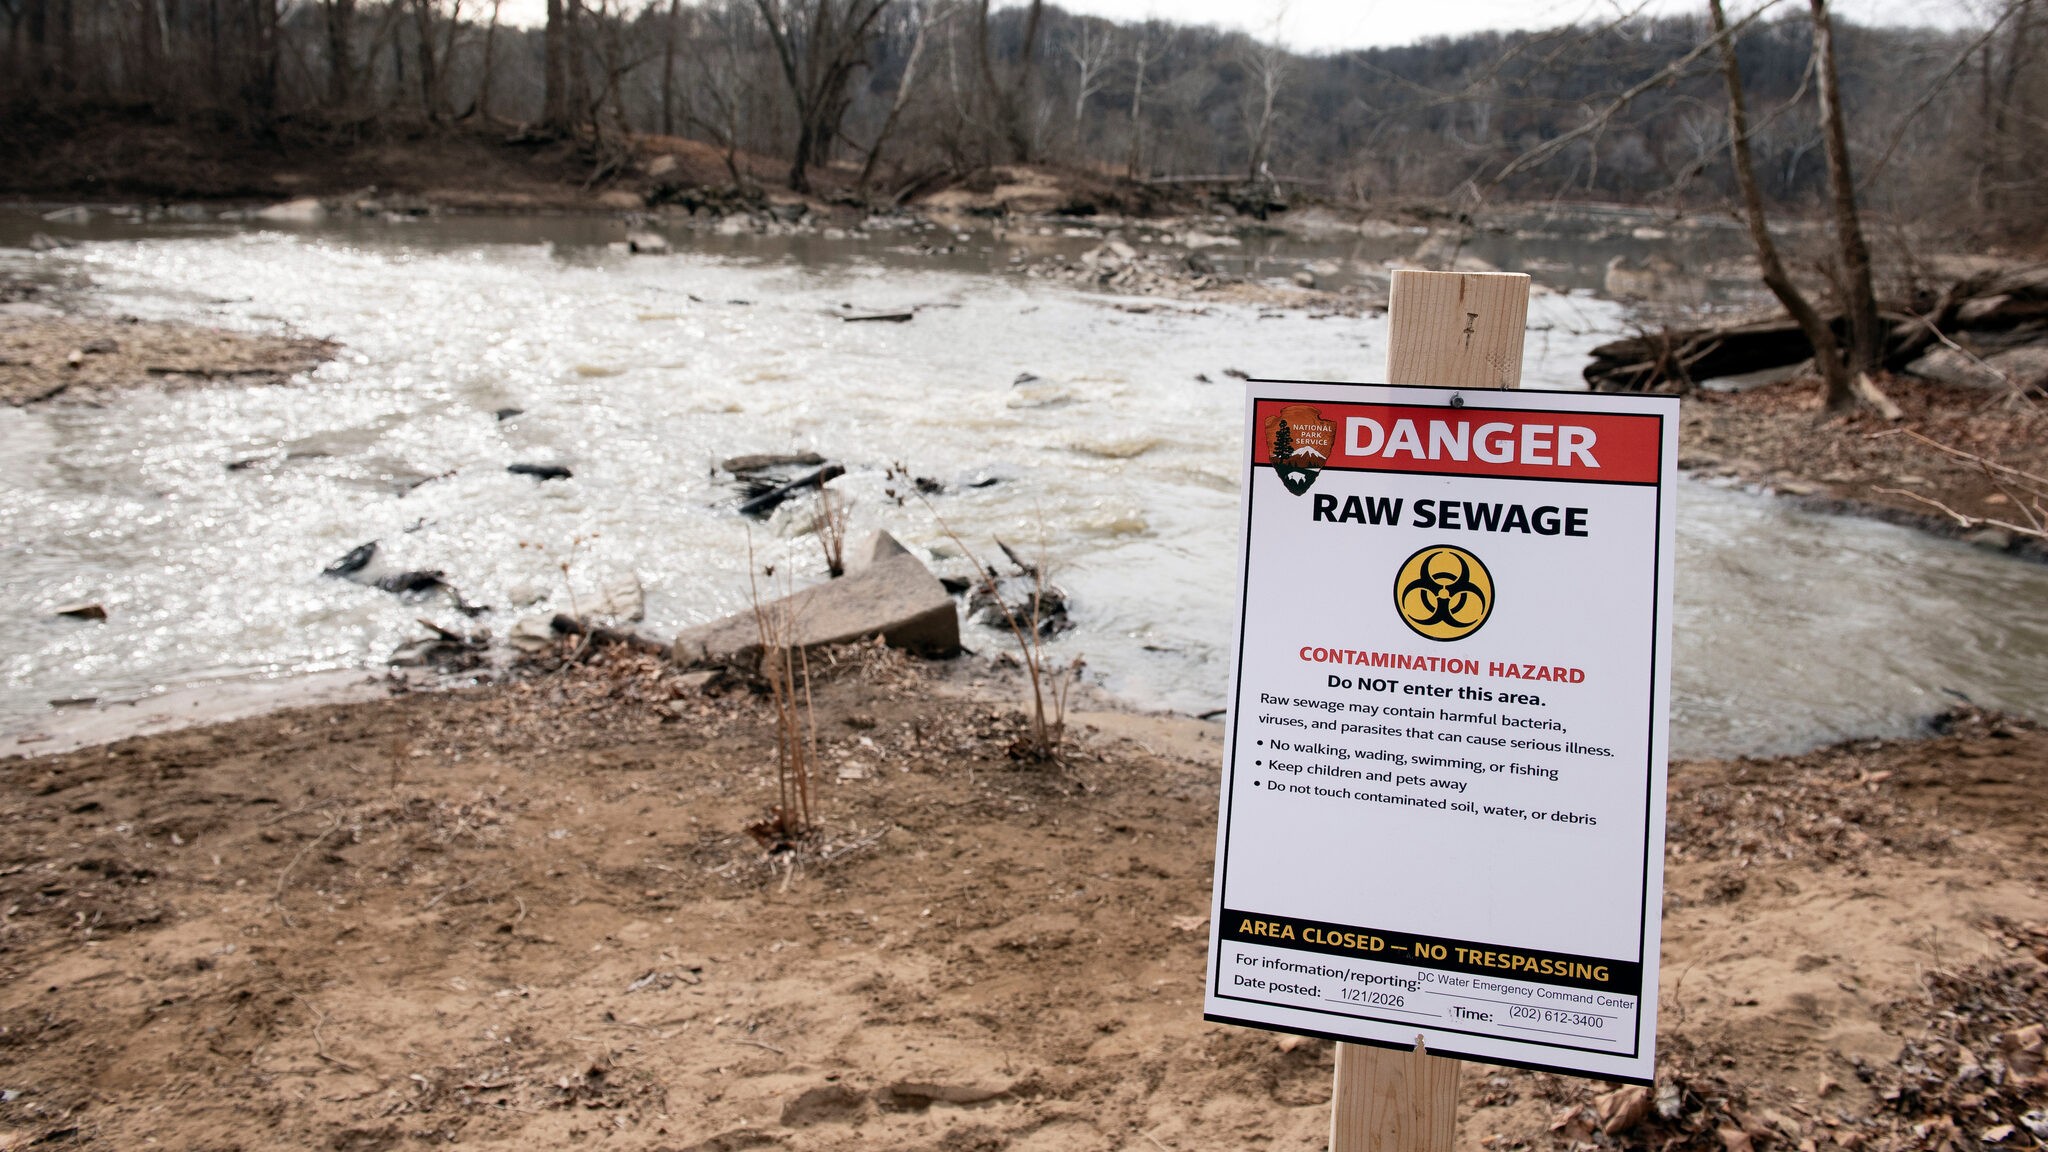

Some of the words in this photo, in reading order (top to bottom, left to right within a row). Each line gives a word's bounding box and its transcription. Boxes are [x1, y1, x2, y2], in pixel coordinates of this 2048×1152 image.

[1293, 424, 1332, 432] NATIONAL
[1296, 438, 1328, 446] SERVICE
[1345, 417, 1601, 468] DANGER
[1313, 493, 1404, 526] RAW
[1413, 499, 1588, 537] SEWAGE
[1300, 647, 1479, 675] CONTAMINATION
[1489, 662, 1585, 683] HAZARD
[1328, 675, 1352, 689] Do
[1358, 677, 1399, 693] NOT
[1403, 684, 1453, 698] enter
[1458, 686, 1493, 701] this
[1498, 693, 1546, 706] area.
[1259, 713, 1307, 730] viruses,
[1311, 720, 1337, 730] and
[1341, 724, 1402, 737] parasites
[1406, 727, 1434, 740] that
[1438, 733, 1462, 742] can
[1466, 736, 1506, 747] cause
[1511, 739, 1561, 752] serious
[1566, 742, 1614, 757] illness.
[1261, 693, 1290, 705] Raw
[1293, 699, 1345, 713] sewage
[1349, 704, 1379, 717] may
[1383, 707, 1435, 719] contain
[1440, 709, 1497, 725] harmful
[1502, 714, 1566, 734] bacteria,
[1269, 760, 1303, 775] Keep
[1307, 764, 1361, 779] children
[1366, 772, 1392, 782] and
[1396, 776, 1426, 786] pets
[1430, 779, 1467, 793] away
[1270, 739, 1290, 751] No
[1294, 743, 1350, 760] walking,
[1355, 750, 1407, 766] wading,
[1411, 755, 1486, 774] swimming,
[1490, 764, 1505, 772] or
[1509, 763, 1558, 781] fishing
[1268, 780, 1286, 791] Do
[1290, 785, 1311, 794] not
[1314, 786, 1350, 799] touch
[1354, 792, 1446, 809] contaminated
[1451, 801, 1478, 815] soil,
[1483, 806, 1527, 820] water,
[1531, 811, 1547, 820] or
[1551, 811, 1597, 825] debris
[1239, 919, 1295, 940] AREA
[1303, 928, 1384, 951] CLOSED
[1415, 942, 1447, 960] NO
[1455, 948, 1608, 981] TRESPASSING
[1234, 975, 1265, 989] Date
[1269, 981, 1321, 997] posted:
[1341, 988, 1405, 1008] 1/21/2026
[1453, 1006, 1493, 1022] Time:
[1509, 1006, 1541, 1022] (202)
[1545, 1011, 1603, 1029] 612-3400
[1236, 953, 1258, 966] For
[1262, 957, 1421, 992] information/reporting:
[1418, 972, 1435, 983] DC
[1438, 974, 1470, 988] Water
[1473, 980, 1533, 998] Emergency
[1537, 988, 1593, 1004] Command
[1597, 996, 1634, 1010] Center
